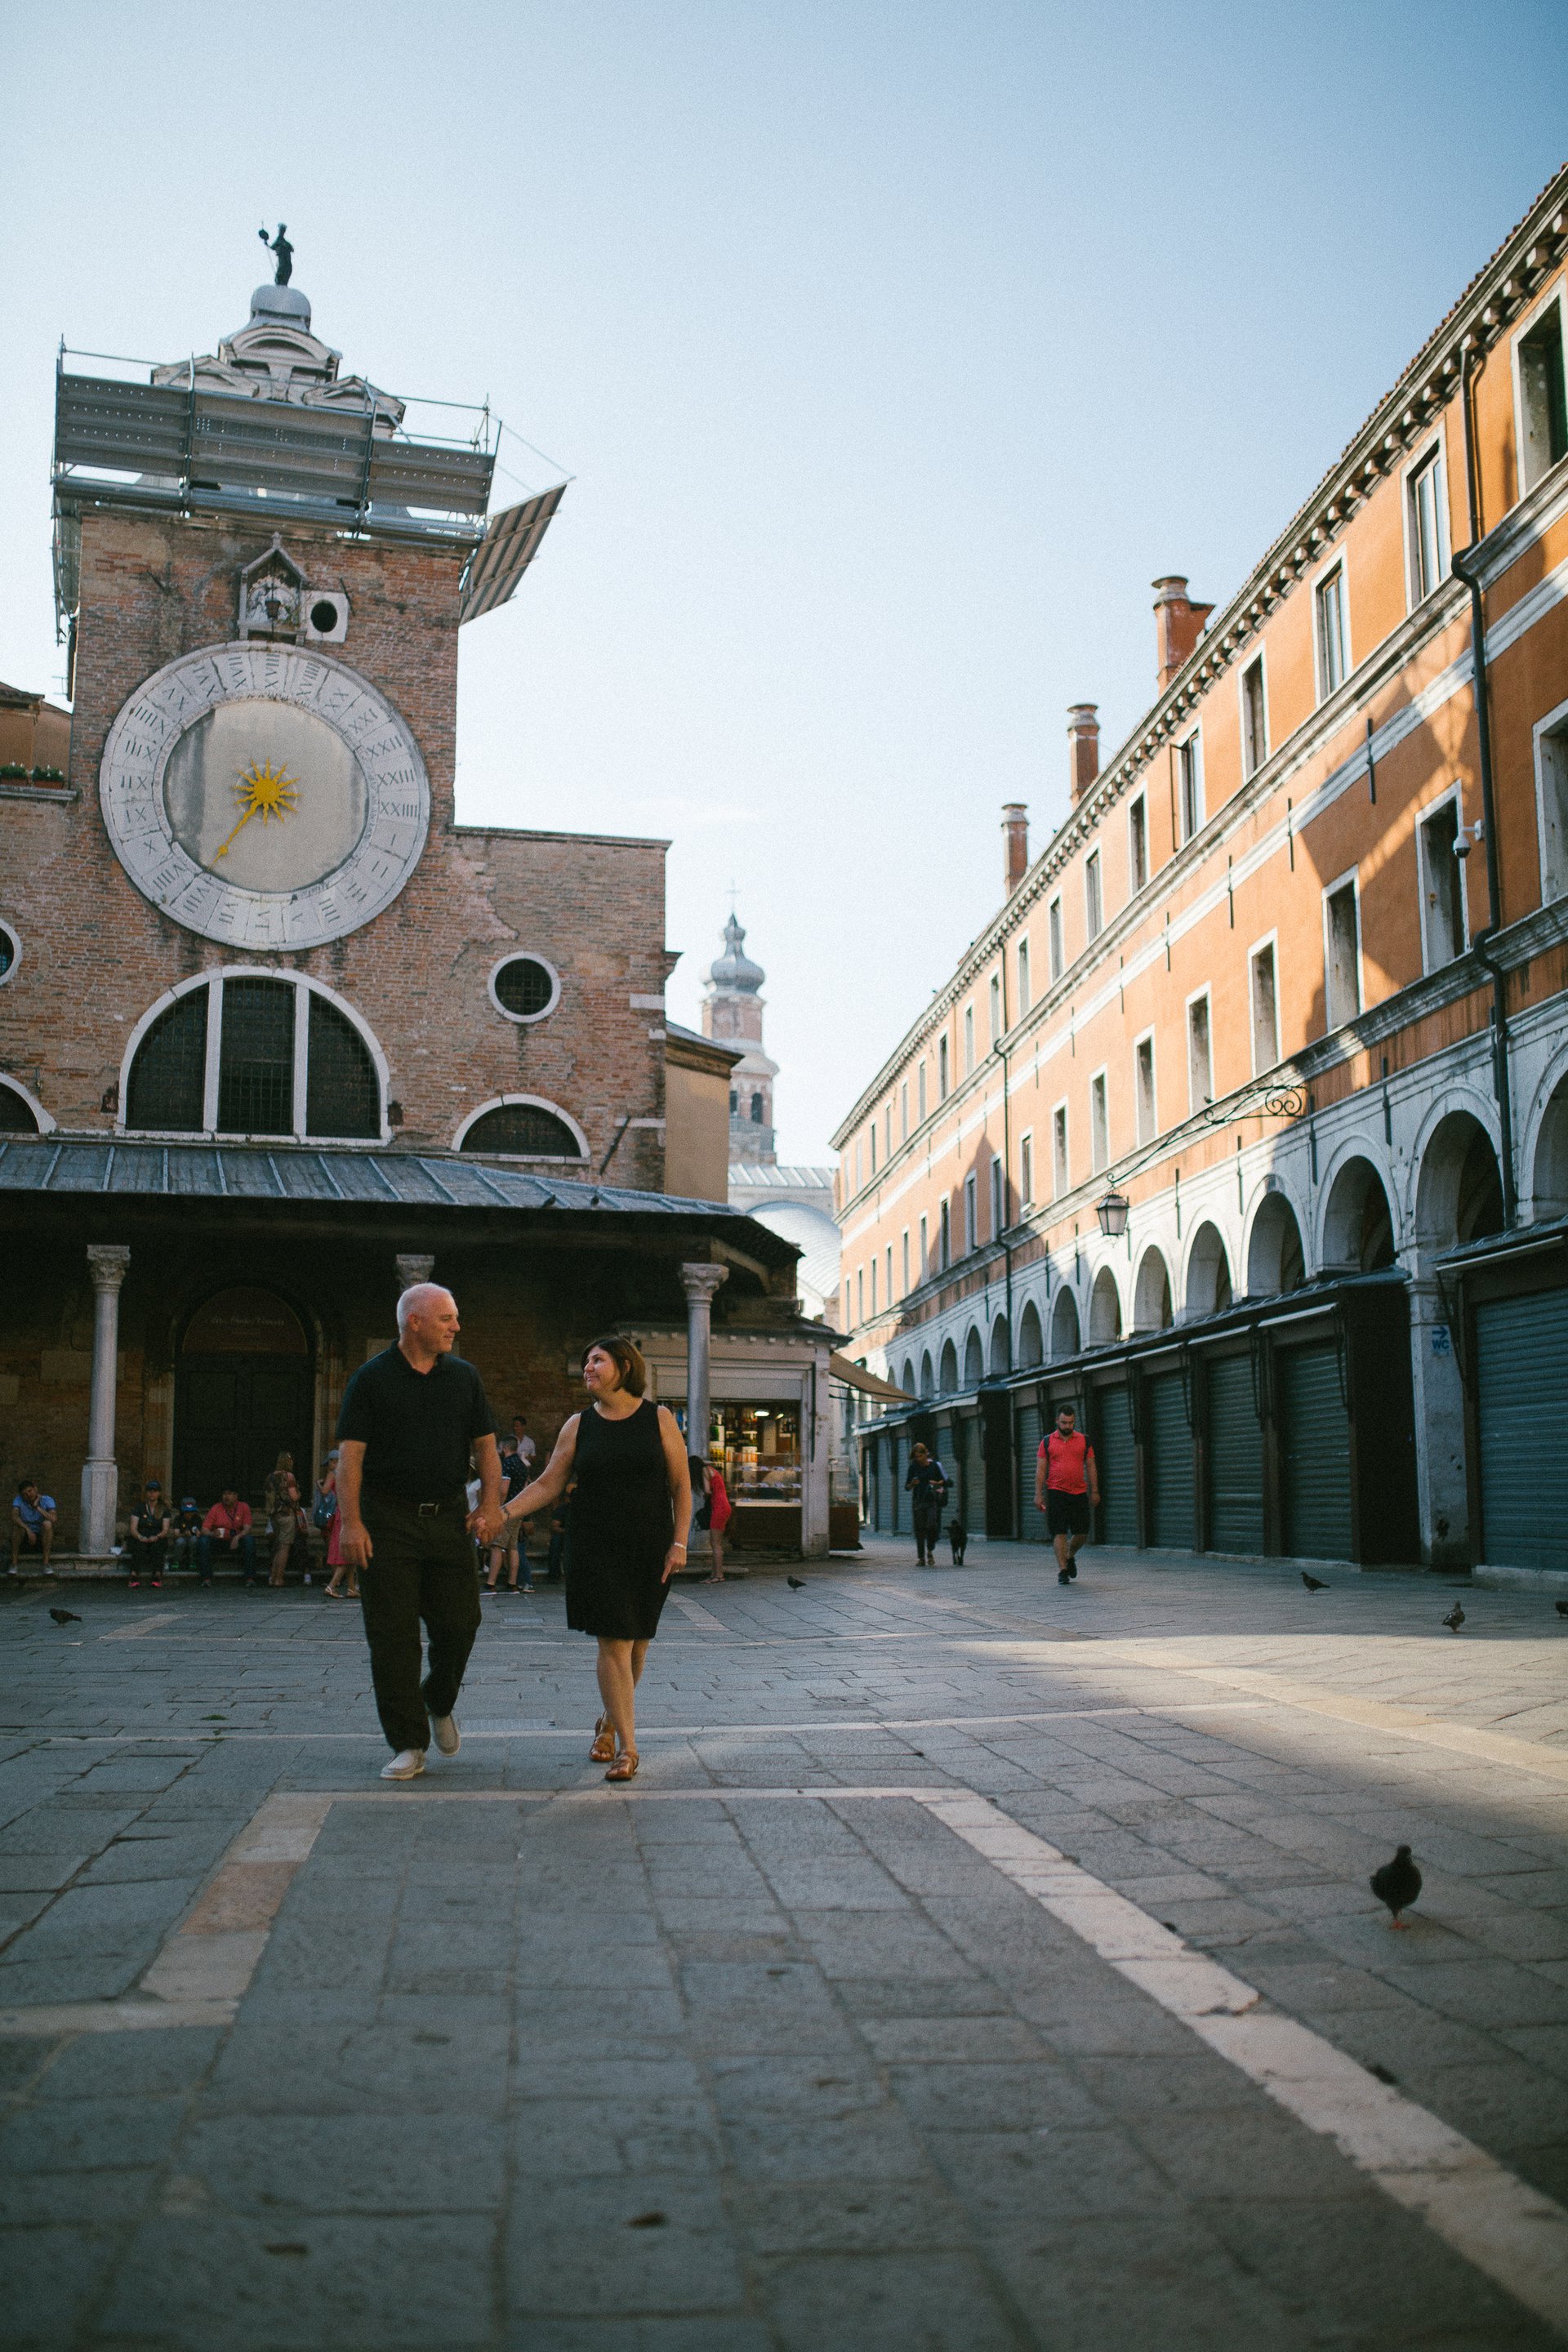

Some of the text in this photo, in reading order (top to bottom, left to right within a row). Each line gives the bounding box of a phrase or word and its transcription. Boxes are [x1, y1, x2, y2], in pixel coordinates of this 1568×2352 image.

[367, 735, 403, 759] XXII
[377, 768, 415, 786] XXIII
[380, 801, 418, 817] XXIIII
[1432, 1339, 1450, 1350] WC
